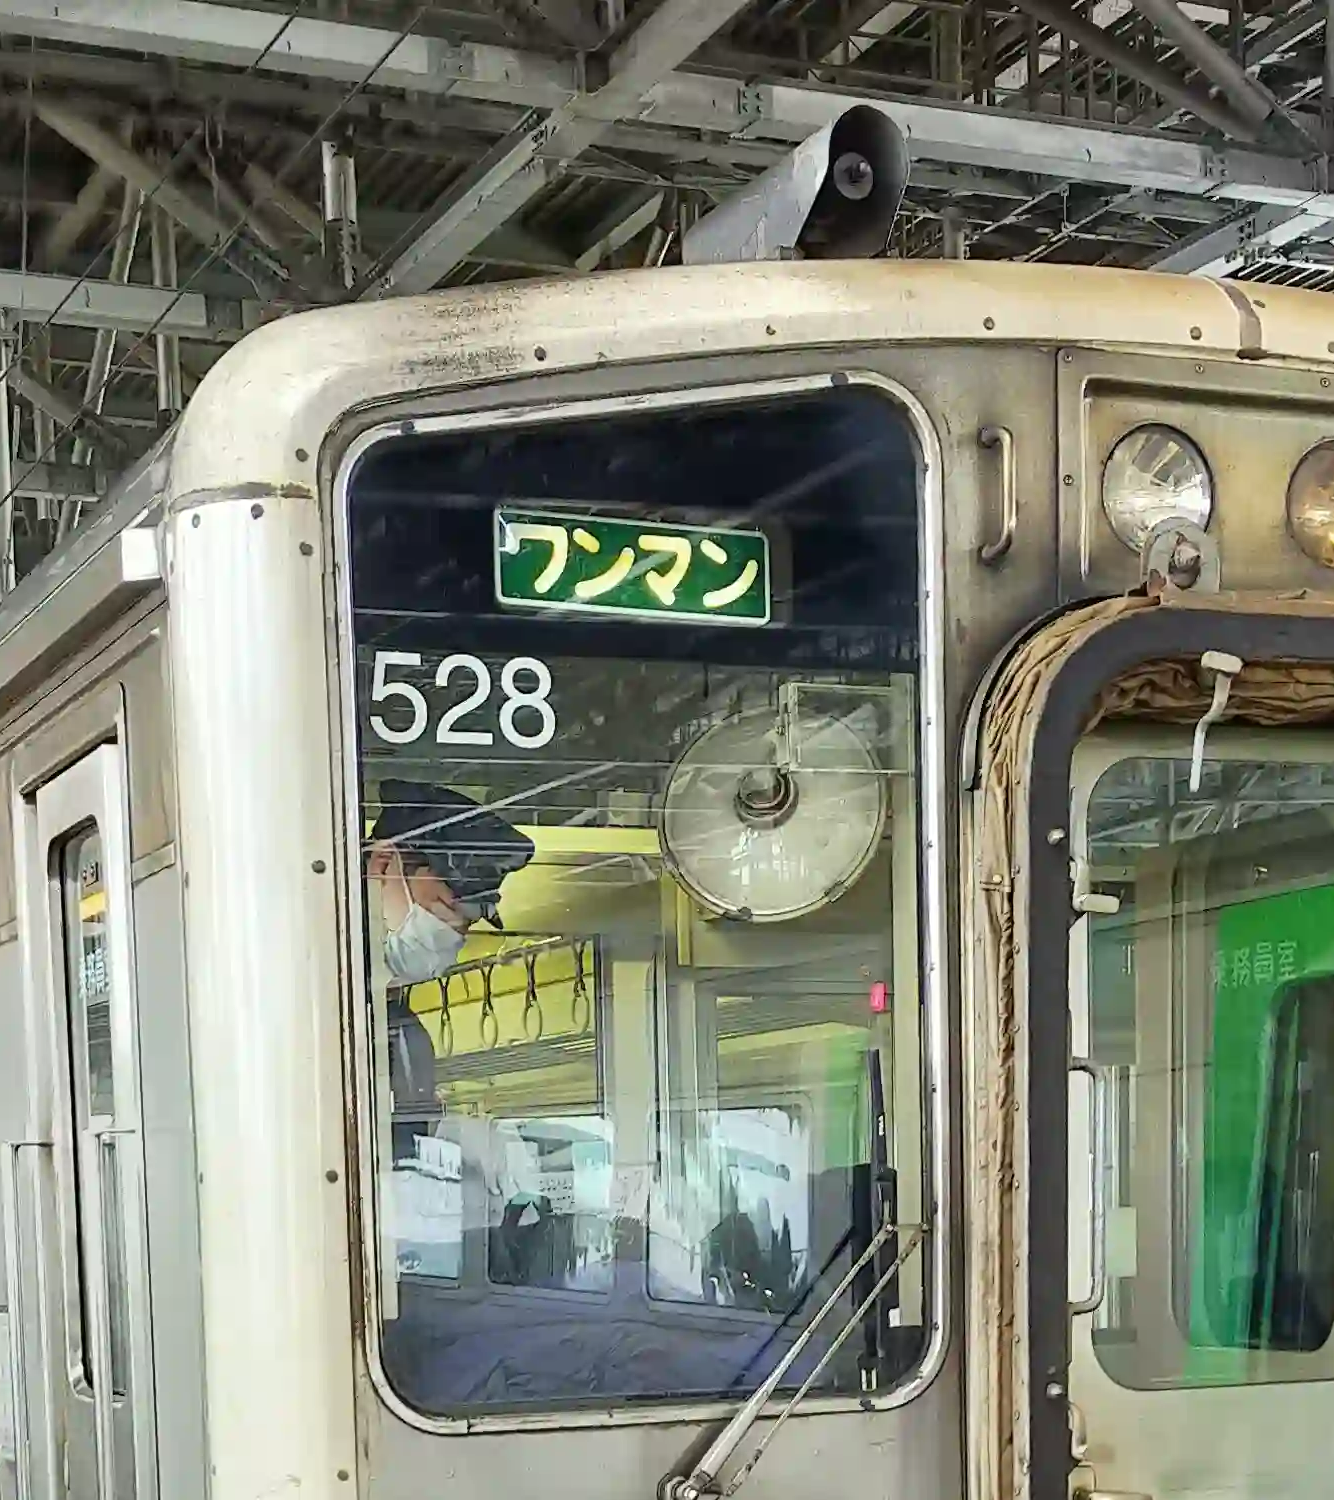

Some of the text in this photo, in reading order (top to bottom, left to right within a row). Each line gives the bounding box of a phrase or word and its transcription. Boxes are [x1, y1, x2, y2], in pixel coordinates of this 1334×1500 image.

[504, 523, 759, 607] ワンマン
[369, 650, 557, 749] 528
